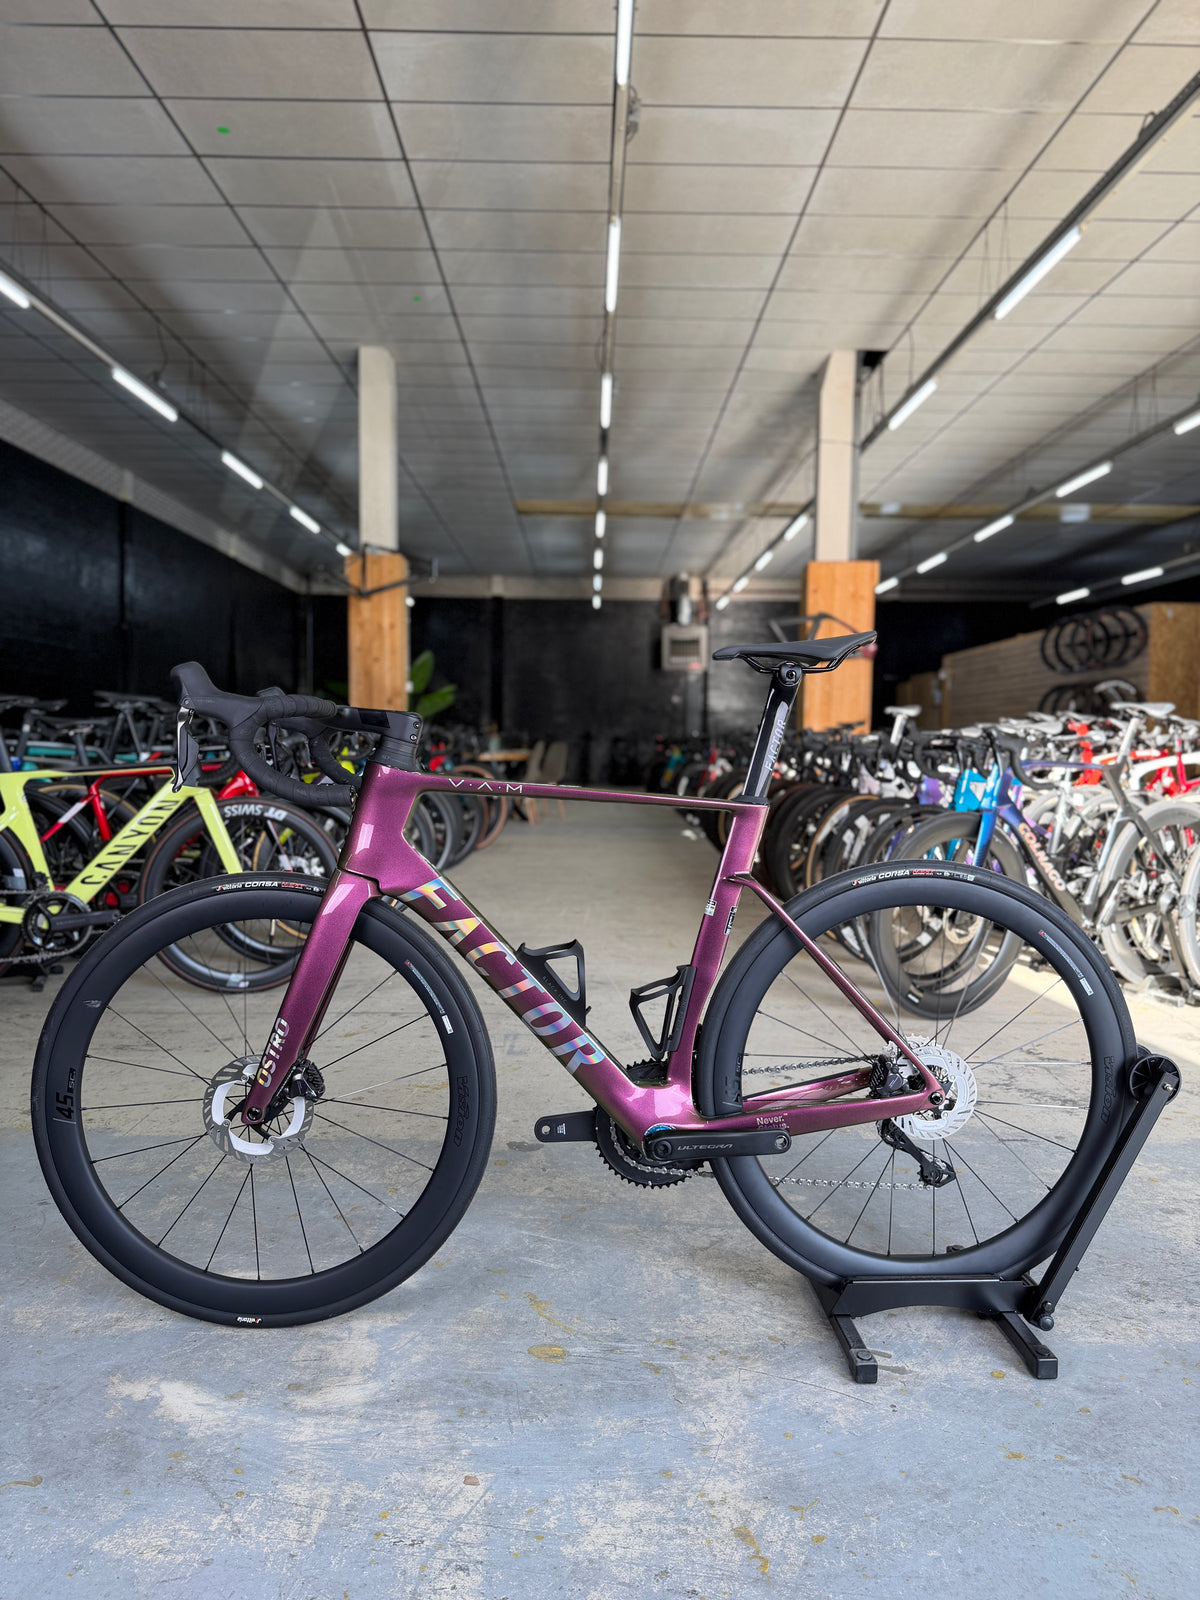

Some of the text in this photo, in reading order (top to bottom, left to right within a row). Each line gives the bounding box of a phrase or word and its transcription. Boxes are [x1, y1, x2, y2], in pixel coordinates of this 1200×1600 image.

[764, 719, 786, 772] FACTOR
[223, 803, 289, 821] DT SWISS
[80, 800, 180, 885] CANYON
[1018, 822, 1066, 892] COLNAGO
[244, 880, 279, 888] CORSA
[878, 869, 910, 879] CORSA
[398, 877, 606, 1075] FACTOR
[256, 1017, 290, 1088] OSTRO
[55, 1091, 75, 1120] 45
[677, 1143, 734, 1151] ULTEGRA
